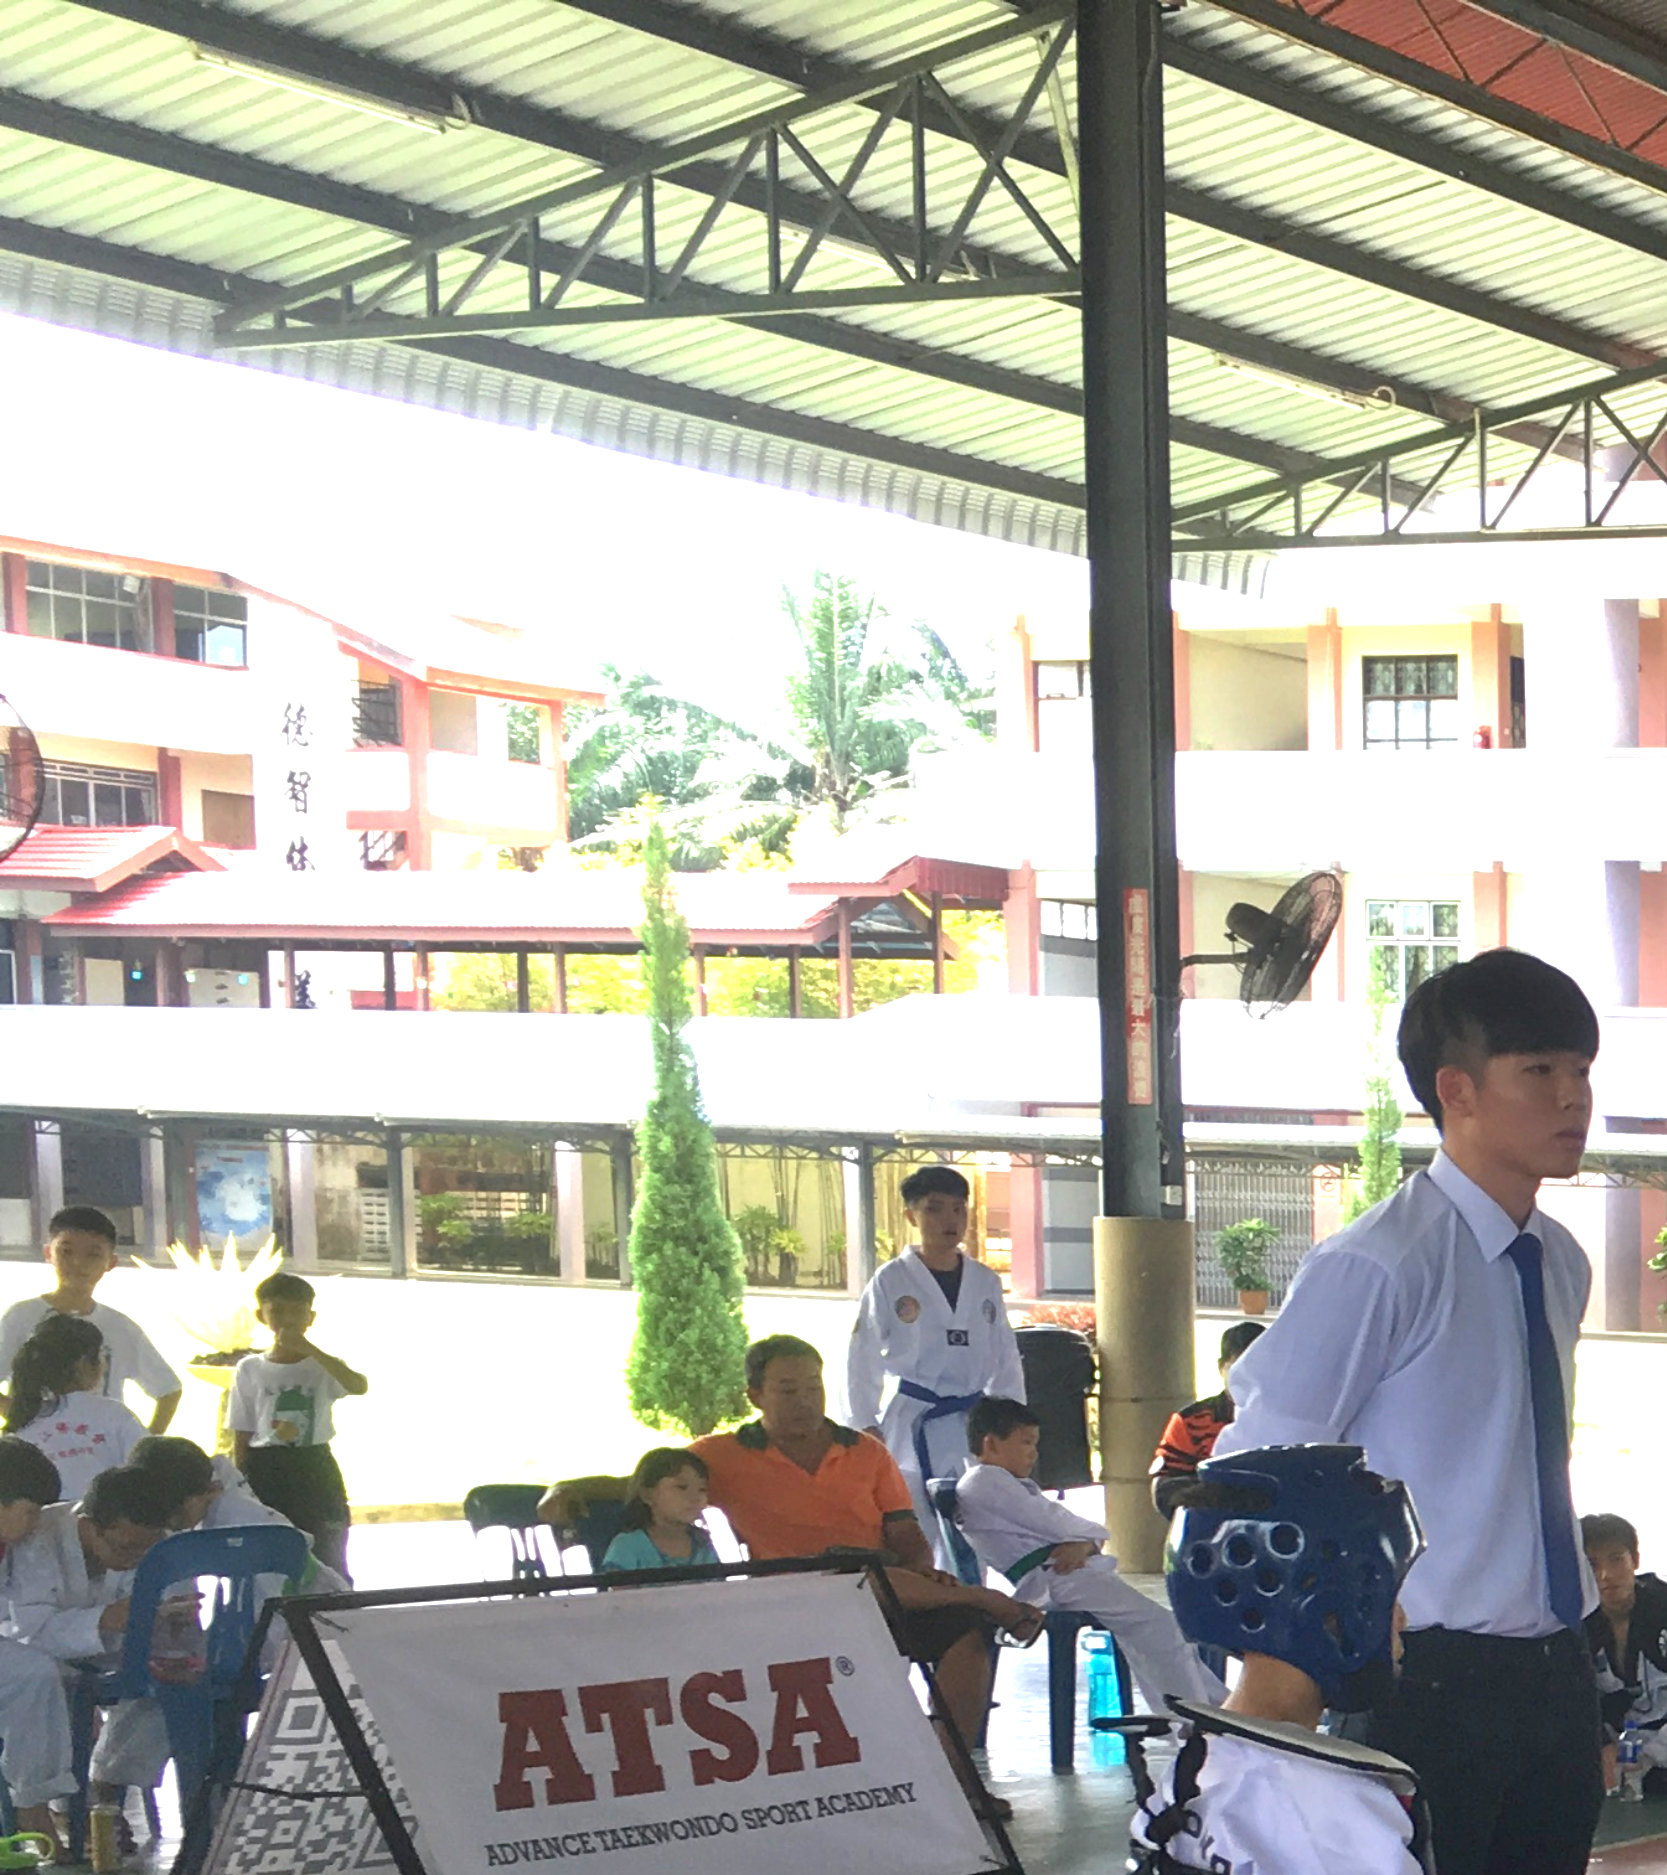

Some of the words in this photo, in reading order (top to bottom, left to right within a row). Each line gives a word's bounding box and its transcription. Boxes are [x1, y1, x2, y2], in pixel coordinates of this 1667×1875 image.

[492, 1656, 862, 1813] ATSA
[484, 1831, 596, 1867] ADVANCE
[594, 1811, 739, 1853] TAEKWONDO
[741, 1800, 815, 1831] SPORT
[814, 1781, 917, 1818] ACADEMY
